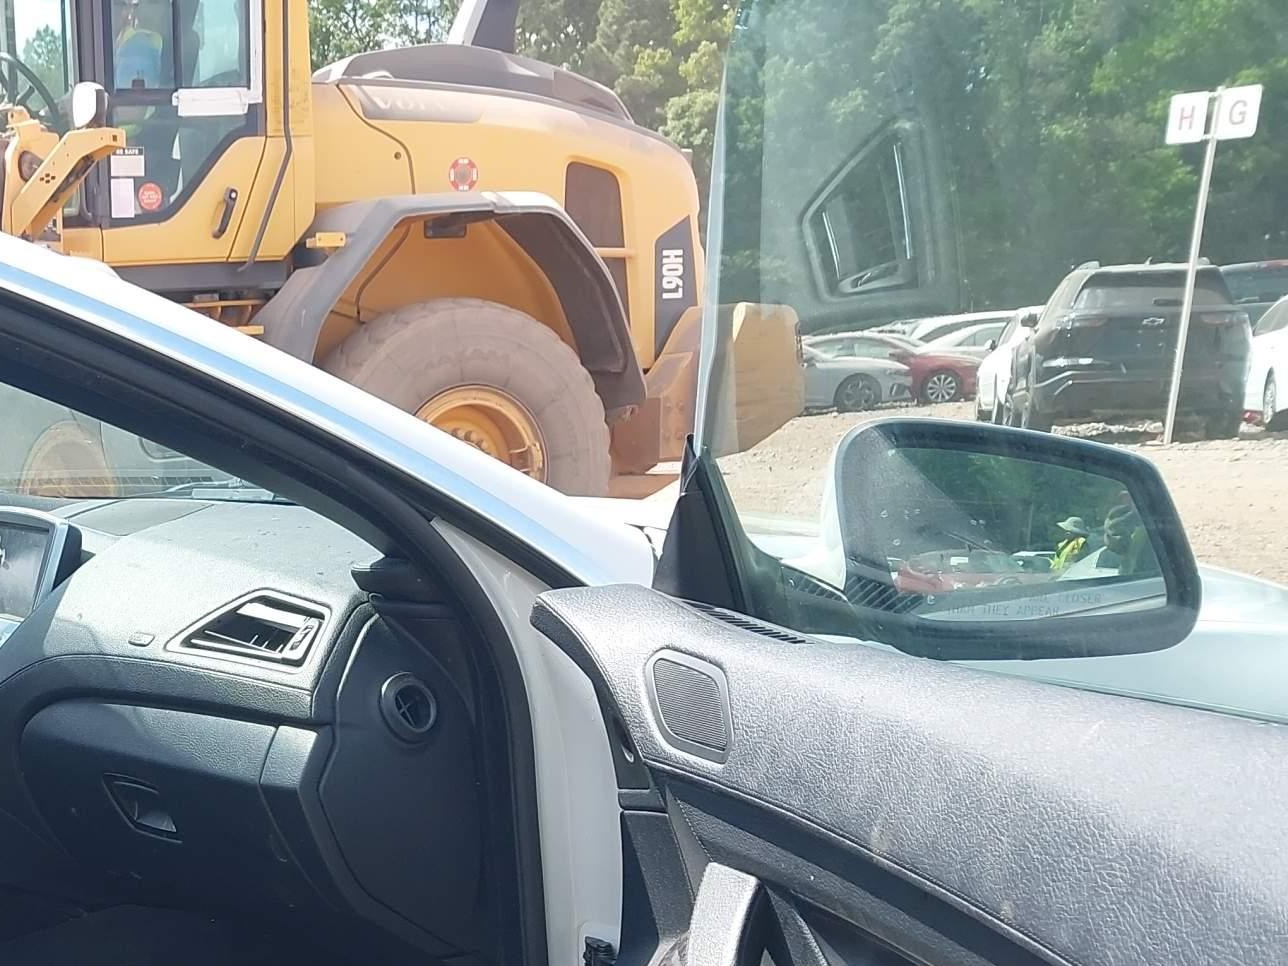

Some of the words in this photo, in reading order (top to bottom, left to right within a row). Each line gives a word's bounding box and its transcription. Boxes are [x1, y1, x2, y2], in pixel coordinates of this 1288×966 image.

[1178, 105, 1196, 130] H
[1229, 99, 1248, 125] G
[662, 249, 683, 299] L90H
